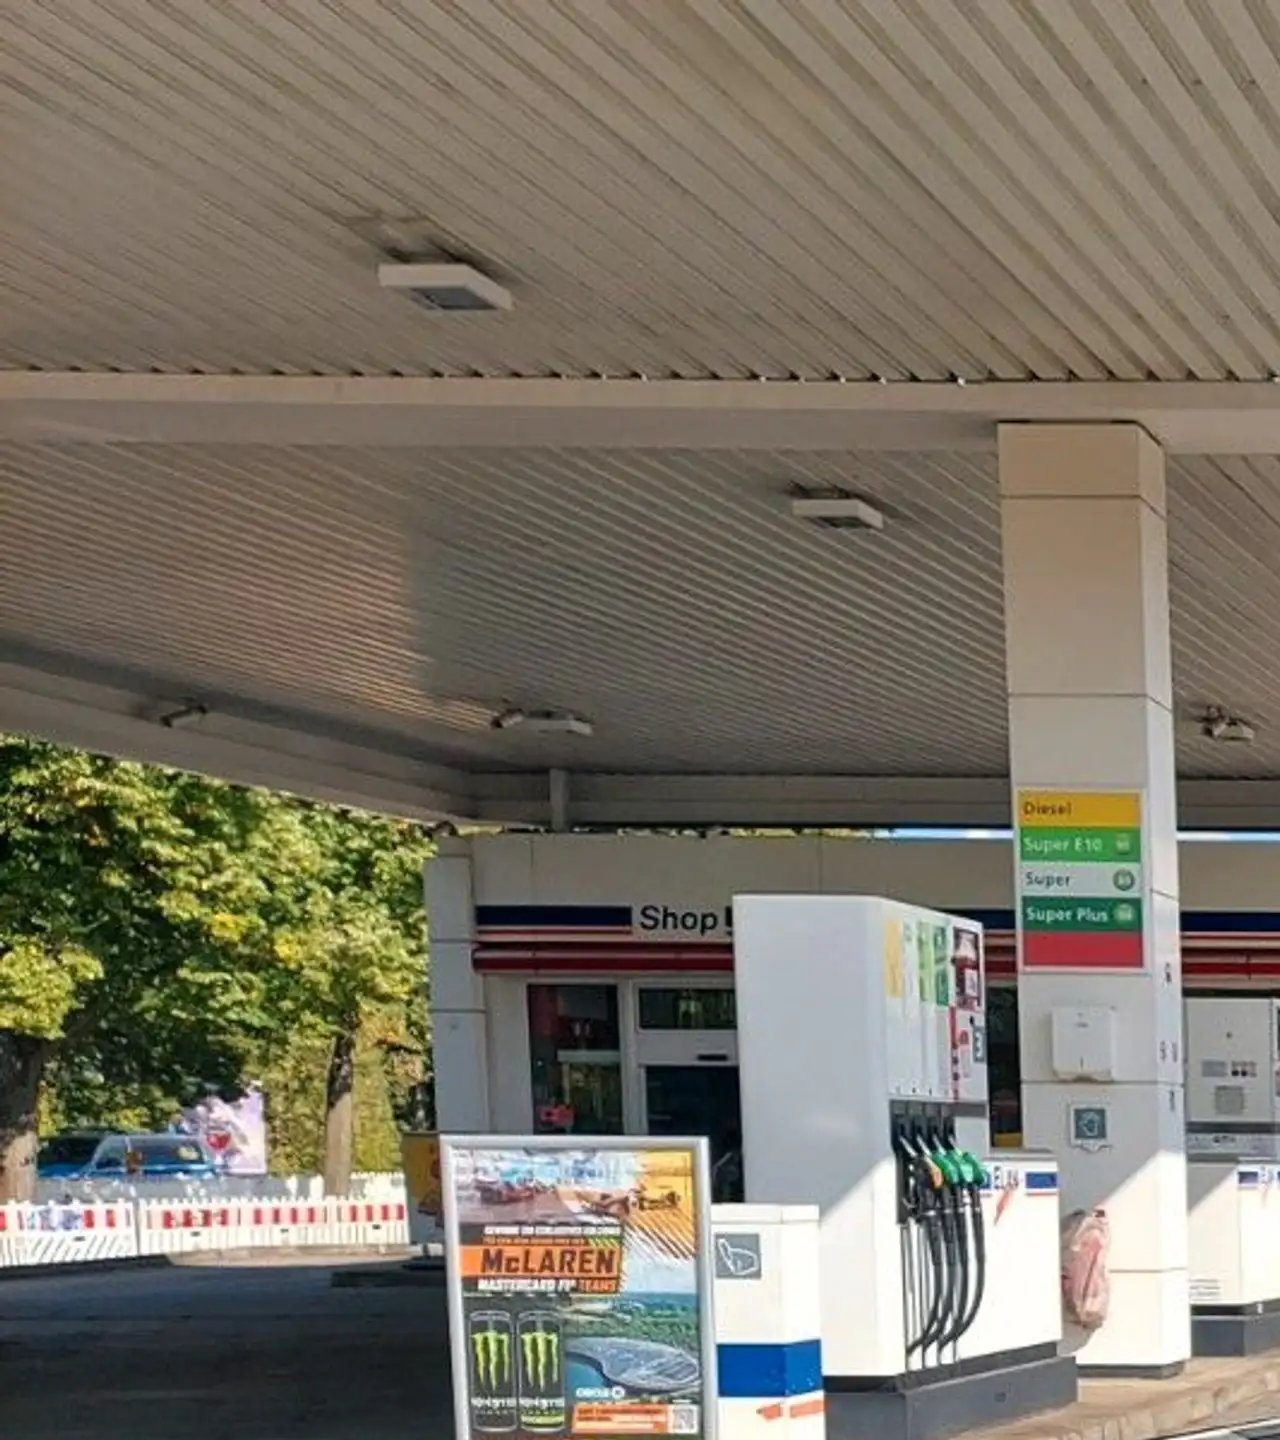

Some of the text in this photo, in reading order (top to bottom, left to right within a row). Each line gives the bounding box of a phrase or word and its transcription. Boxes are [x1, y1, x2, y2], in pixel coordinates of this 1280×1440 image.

[1023, 801, 1072, 816] Diesel
[1024, 836, 1069, 854] Super
[1074, 836, 1103, 851] E10
[1025, 871, 1071, 887] Super
[640, 904, 719, 937] Shop
[1026, 906, 1072, 922] Super
[1077, 906, 1109, 922] Plus
[481, 1248, 616, 1273] McLAREN
